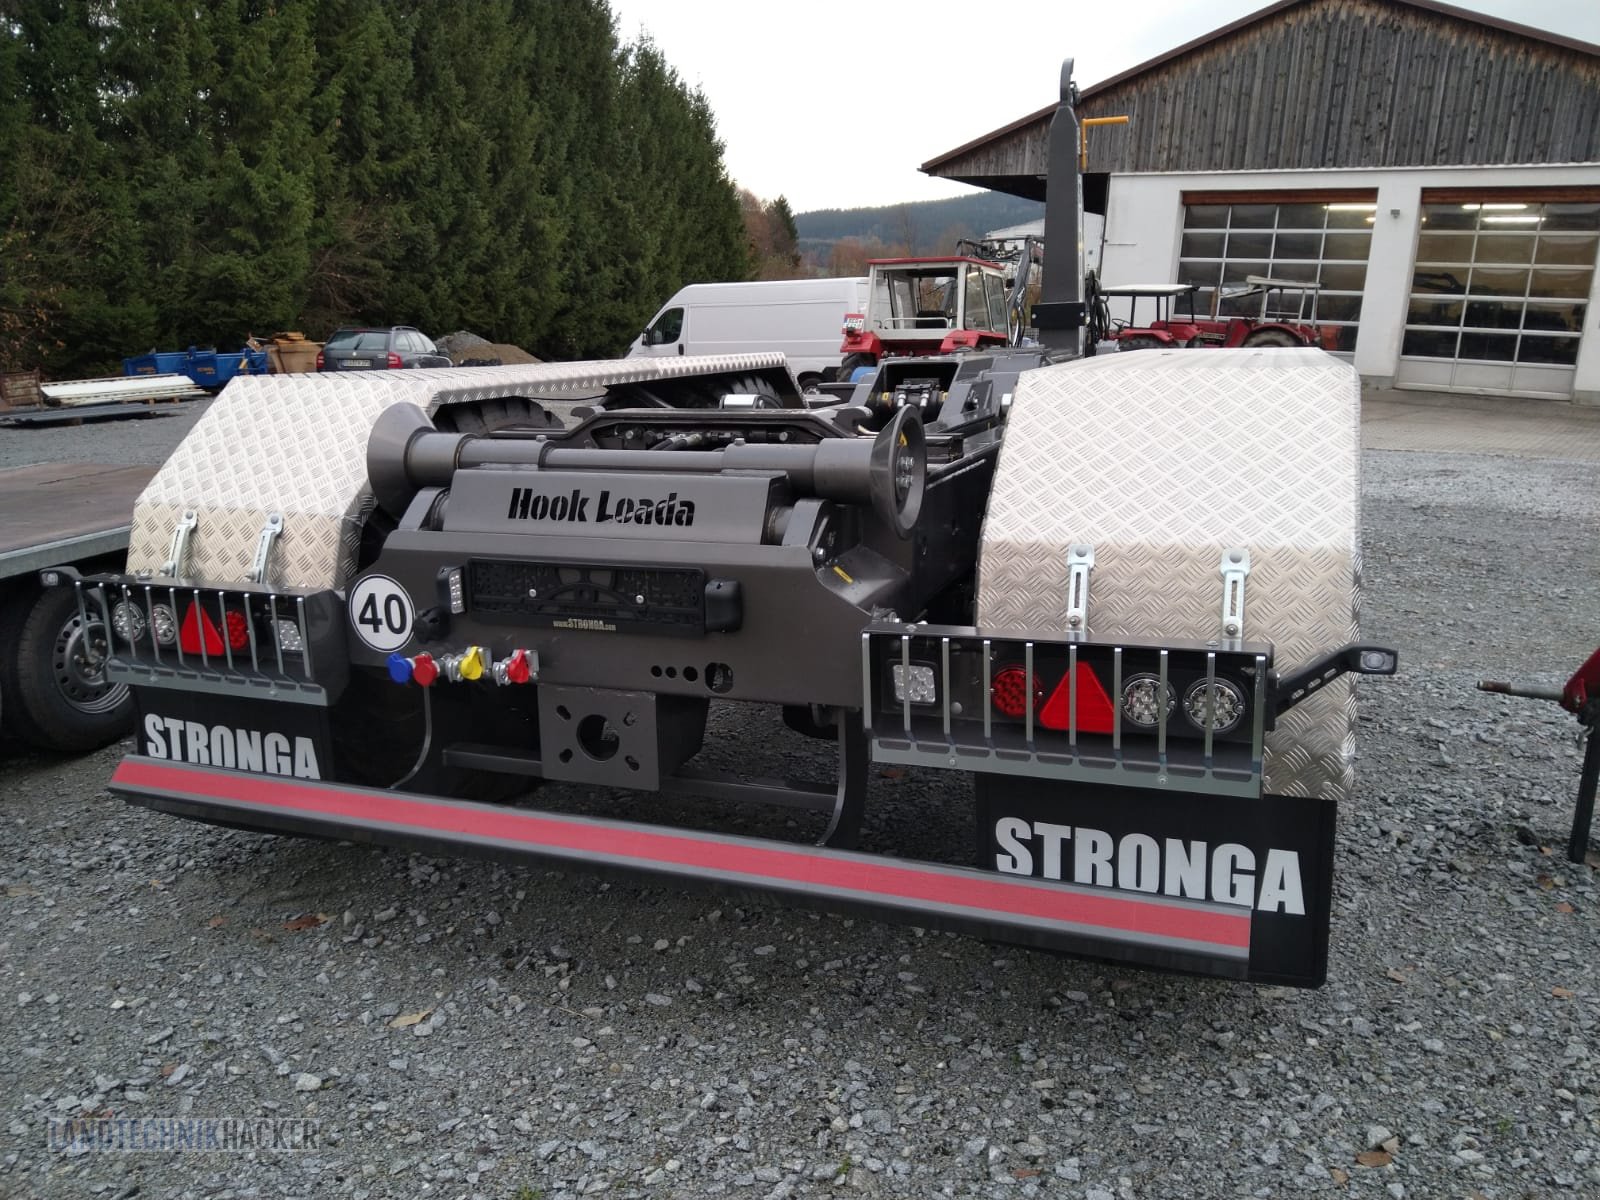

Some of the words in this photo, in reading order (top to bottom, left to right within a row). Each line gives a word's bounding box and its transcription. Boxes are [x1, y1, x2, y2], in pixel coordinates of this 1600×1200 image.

[508, 488, 590, 522] Hook
[596, 490, 695, 526] Loada
[359, 593, 407, 634] 40
[144, 713, 321, 780] STRONGA
[995, 816, 1306, 915] STRONGA
